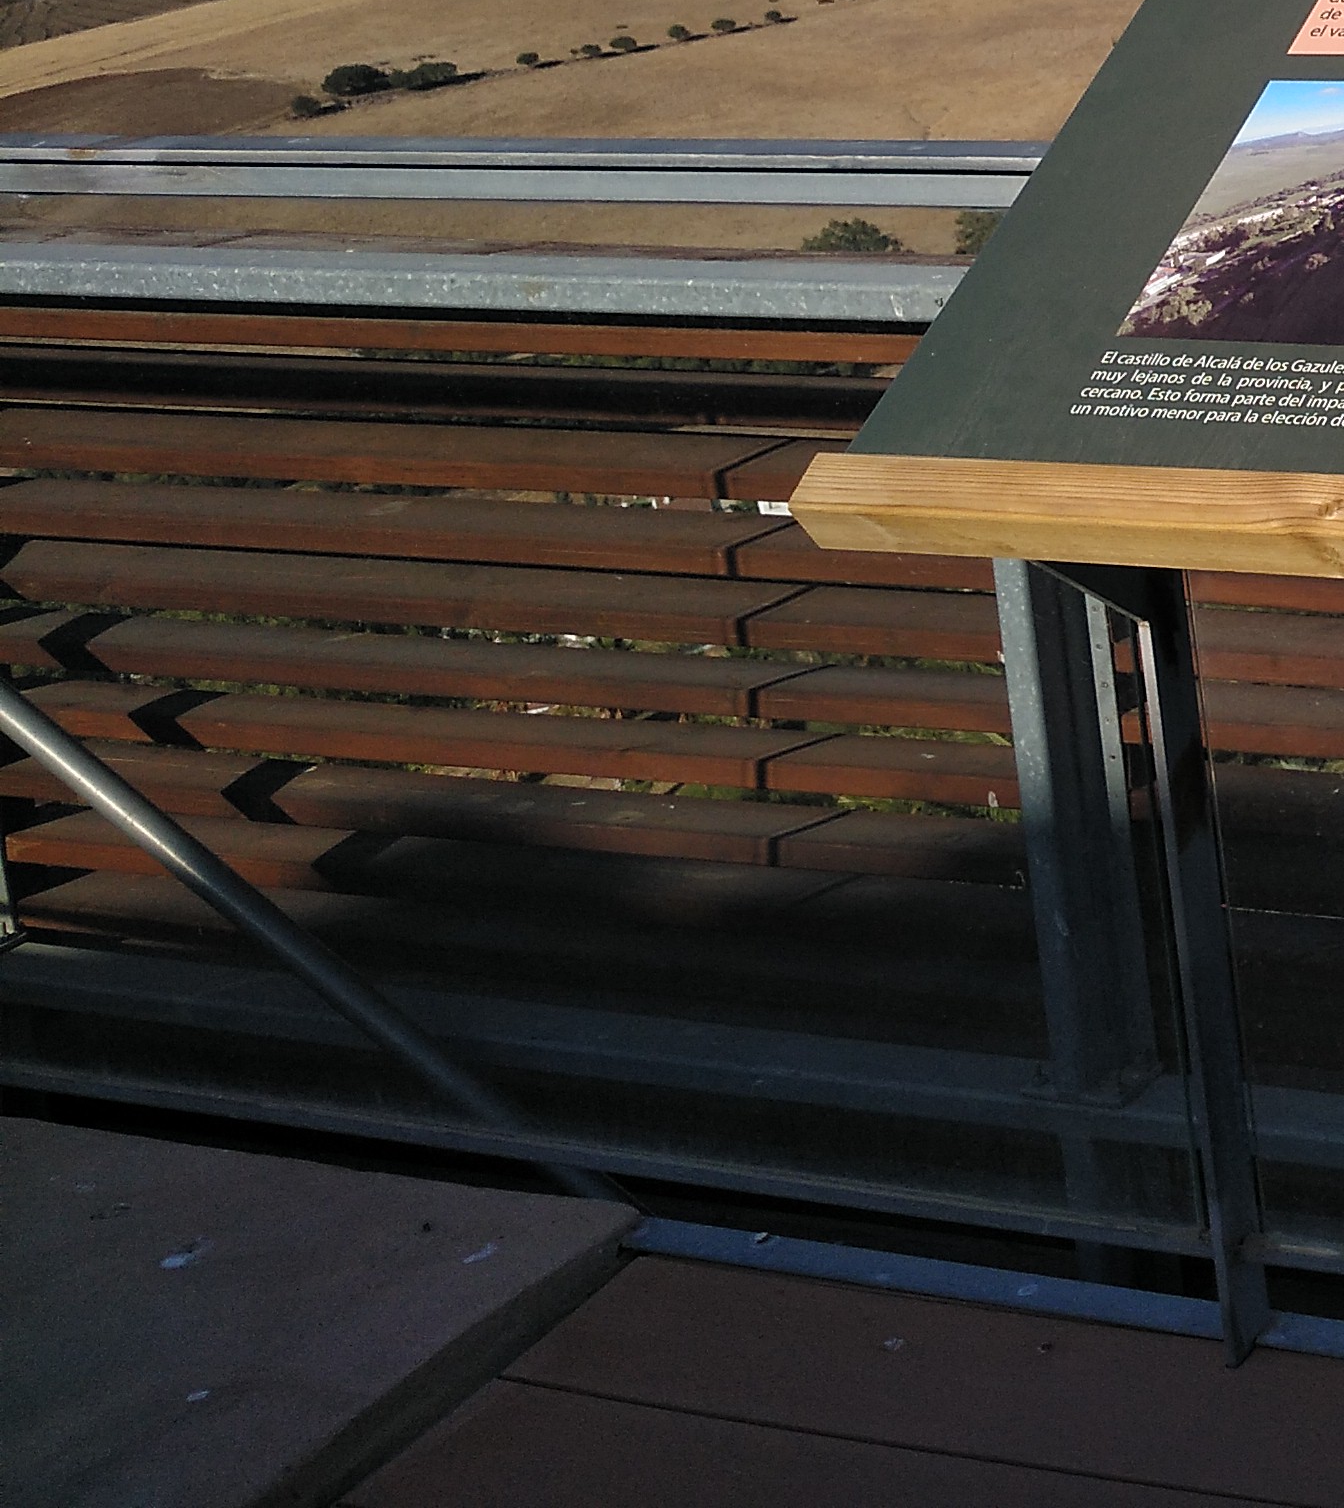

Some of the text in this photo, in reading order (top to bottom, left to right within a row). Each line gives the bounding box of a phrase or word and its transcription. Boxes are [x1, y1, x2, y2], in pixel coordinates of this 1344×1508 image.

[1310, 24, 1328, 37] el
[1070, 404, 1092, 415] un
[1093, 404, 1149, 417] motivo
[1150, 408, 1205, 420] menor
[1203, 411, 1242, 424] para
[1243, 409, 1259, 423] la
[1261, 410, 1328, 426] elección
